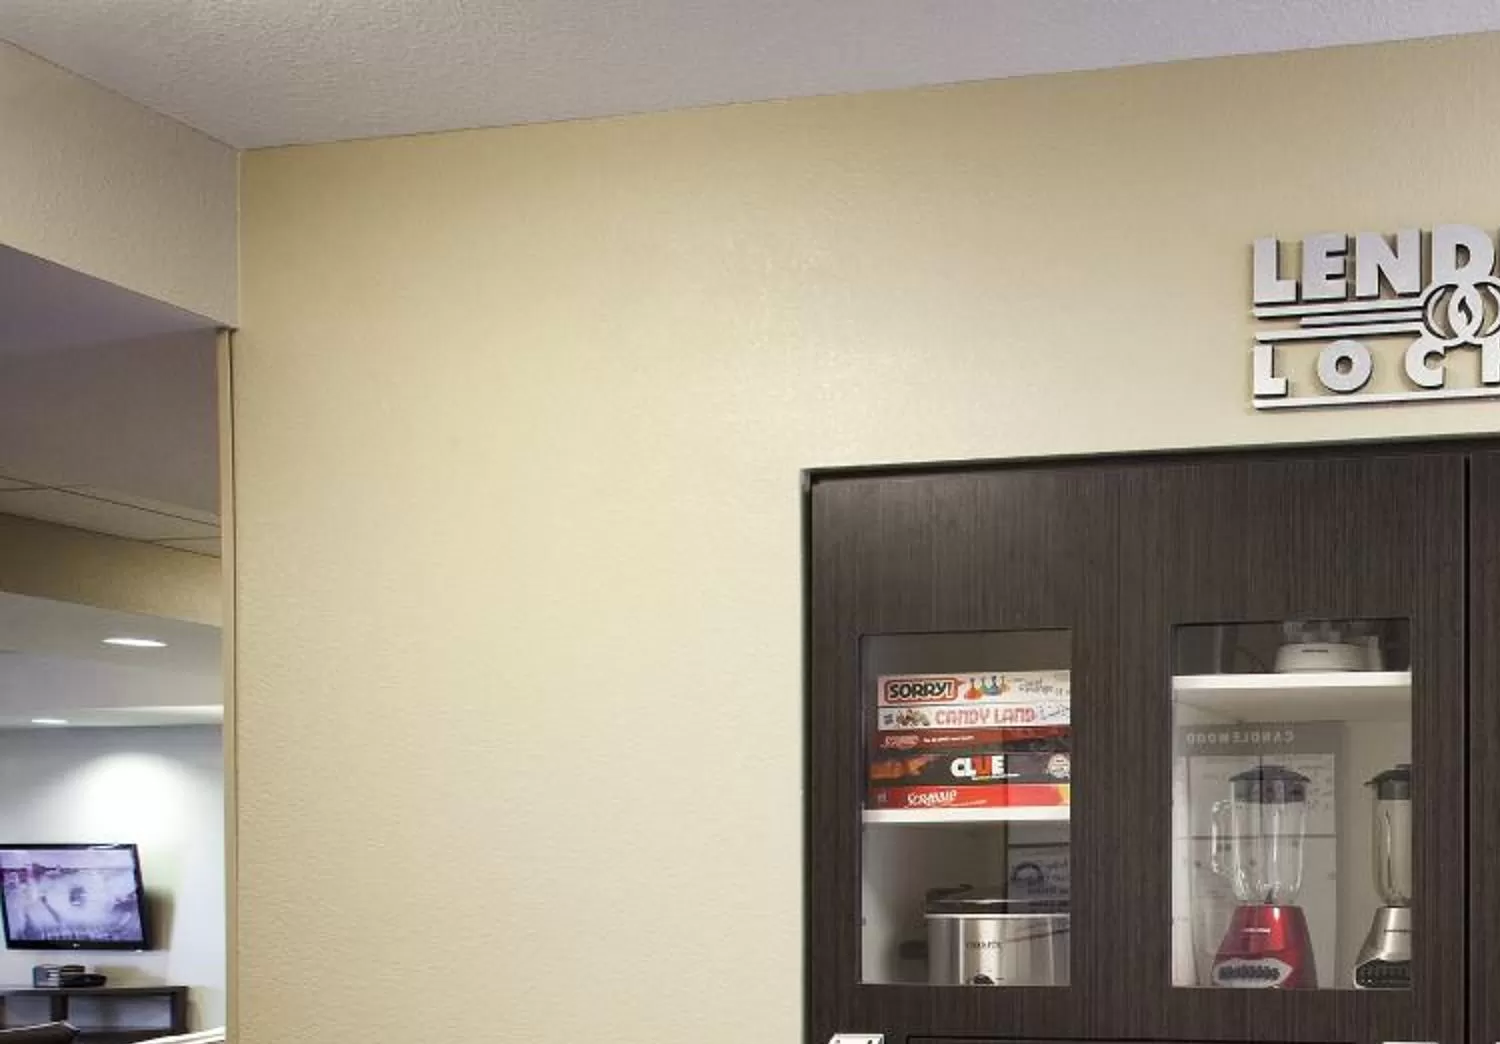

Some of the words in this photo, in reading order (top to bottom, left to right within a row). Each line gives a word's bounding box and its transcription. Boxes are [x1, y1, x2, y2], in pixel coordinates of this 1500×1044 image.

[889, 681, 953, 700] SORRY!
[935, 708, 990, 726] CANDY
[994, 707, 1036, 724] LAND
[950, 754, 1006, 779] CLUE
